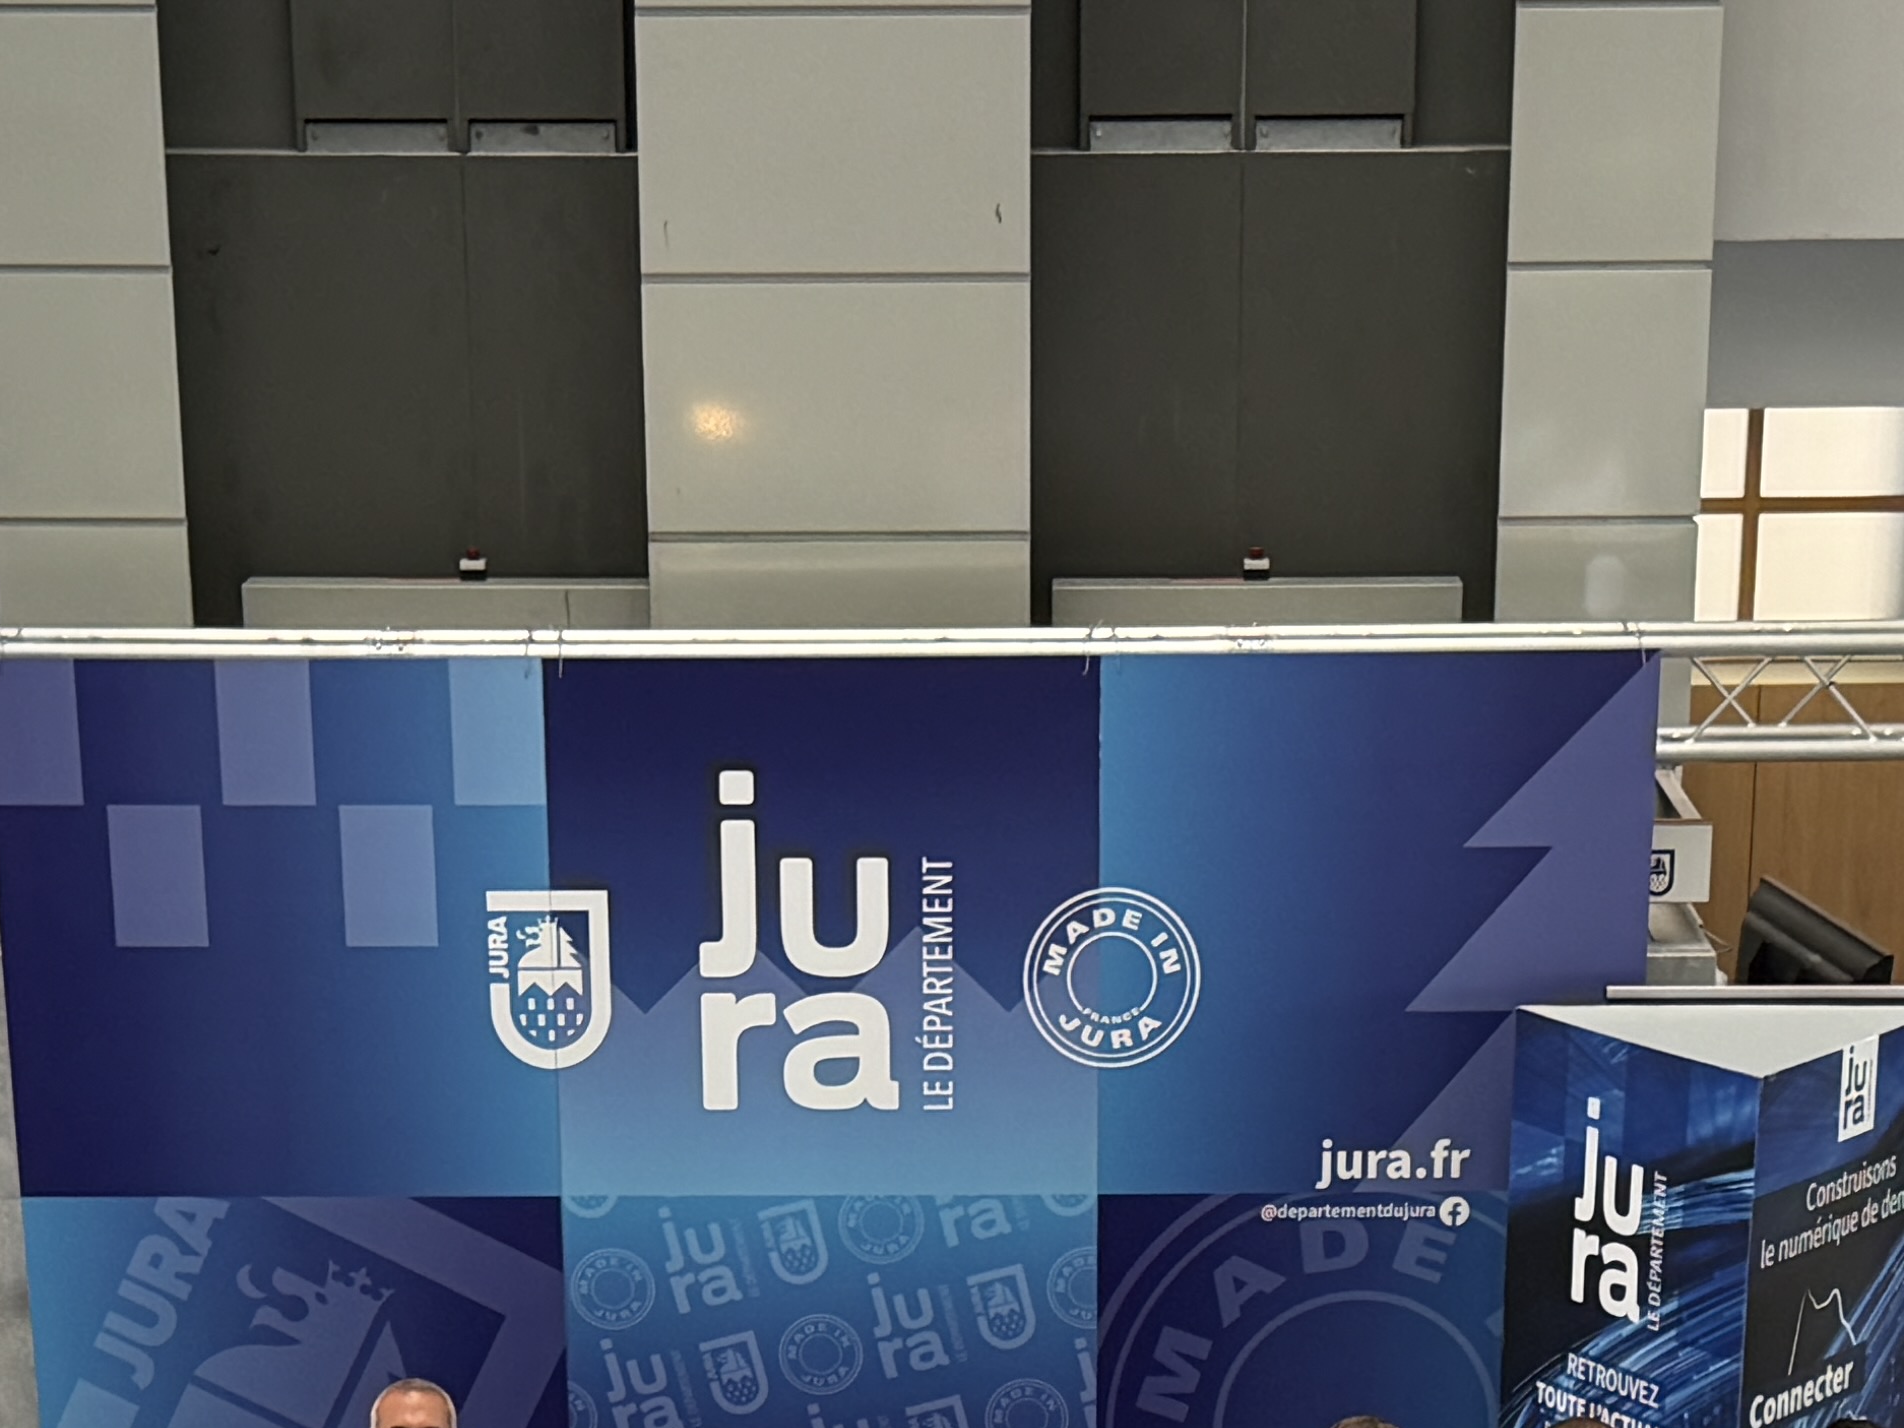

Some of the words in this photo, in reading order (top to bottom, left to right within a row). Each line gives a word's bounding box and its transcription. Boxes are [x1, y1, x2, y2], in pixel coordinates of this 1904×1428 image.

[487, 916, 509, 979] JURA
[915, 857, 953, 1071] DÉPARTEMENT
[1042, 908, 1142, 976] MADE
[1151, 932, 1181, 974] IN
[1059, 1015, 1162, 1049] JURA
[1082, 1008, 1140, 1024] FRANCE
[923, 1080, 953, 1111] LE
[1315, 1139, 1471, 1189] jura.fr
[1806, 1155, 1897, 1211] Construisons
[1261, 1202, 1436, 1222] @departementdujura
[1648, 1171, 1667, 1298] DÉPARTEMENT
[1760, 1239, 1774, 1269] le
[1778, 1215, 1858, 1262] numérique
[1861, 1197, 1878, 1228] de
[93, 1198, 230, 1390] JURA
[1135, 1218, 1456, 1424] MADE
[1647, 1303, 1661, 1332] LE
[1536, 1381, 1585, 1417] TOUTE
[1567, 1352, 1659, 1408] RETROUVEZ
